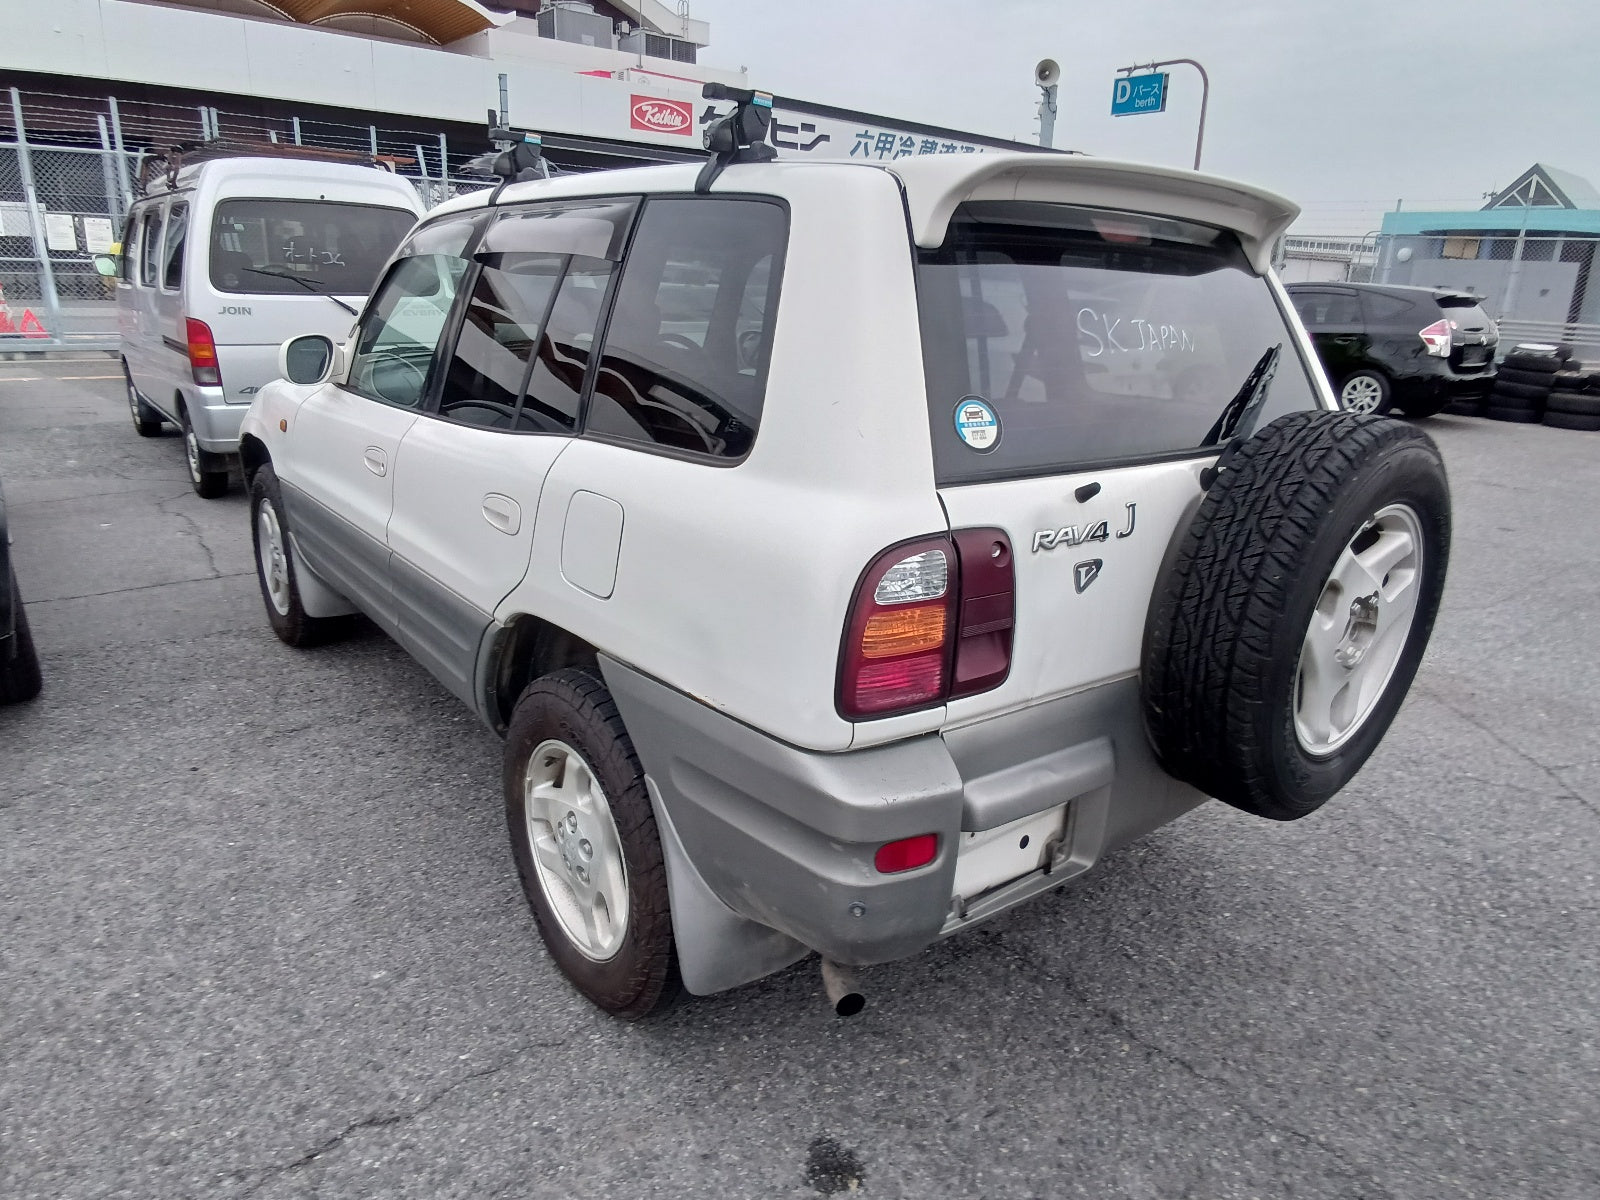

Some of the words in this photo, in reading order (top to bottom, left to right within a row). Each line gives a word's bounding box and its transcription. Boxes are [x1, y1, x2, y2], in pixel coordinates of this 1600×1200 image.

[1116, 80, 1131, 103] D
[1133, 83, 1159, 97] バース
[1134, 97, 1156, 107] berth
[641, 105, 683, 127] Keihin
[218, 306, 251, 316] JOIN
[1077, 308, 1128, 357] SK
[1131, 318, 1195, 353] JAPAN
[1032, 520, 1109, 553] RAV4
[1116, 502, 1137, 539] J
